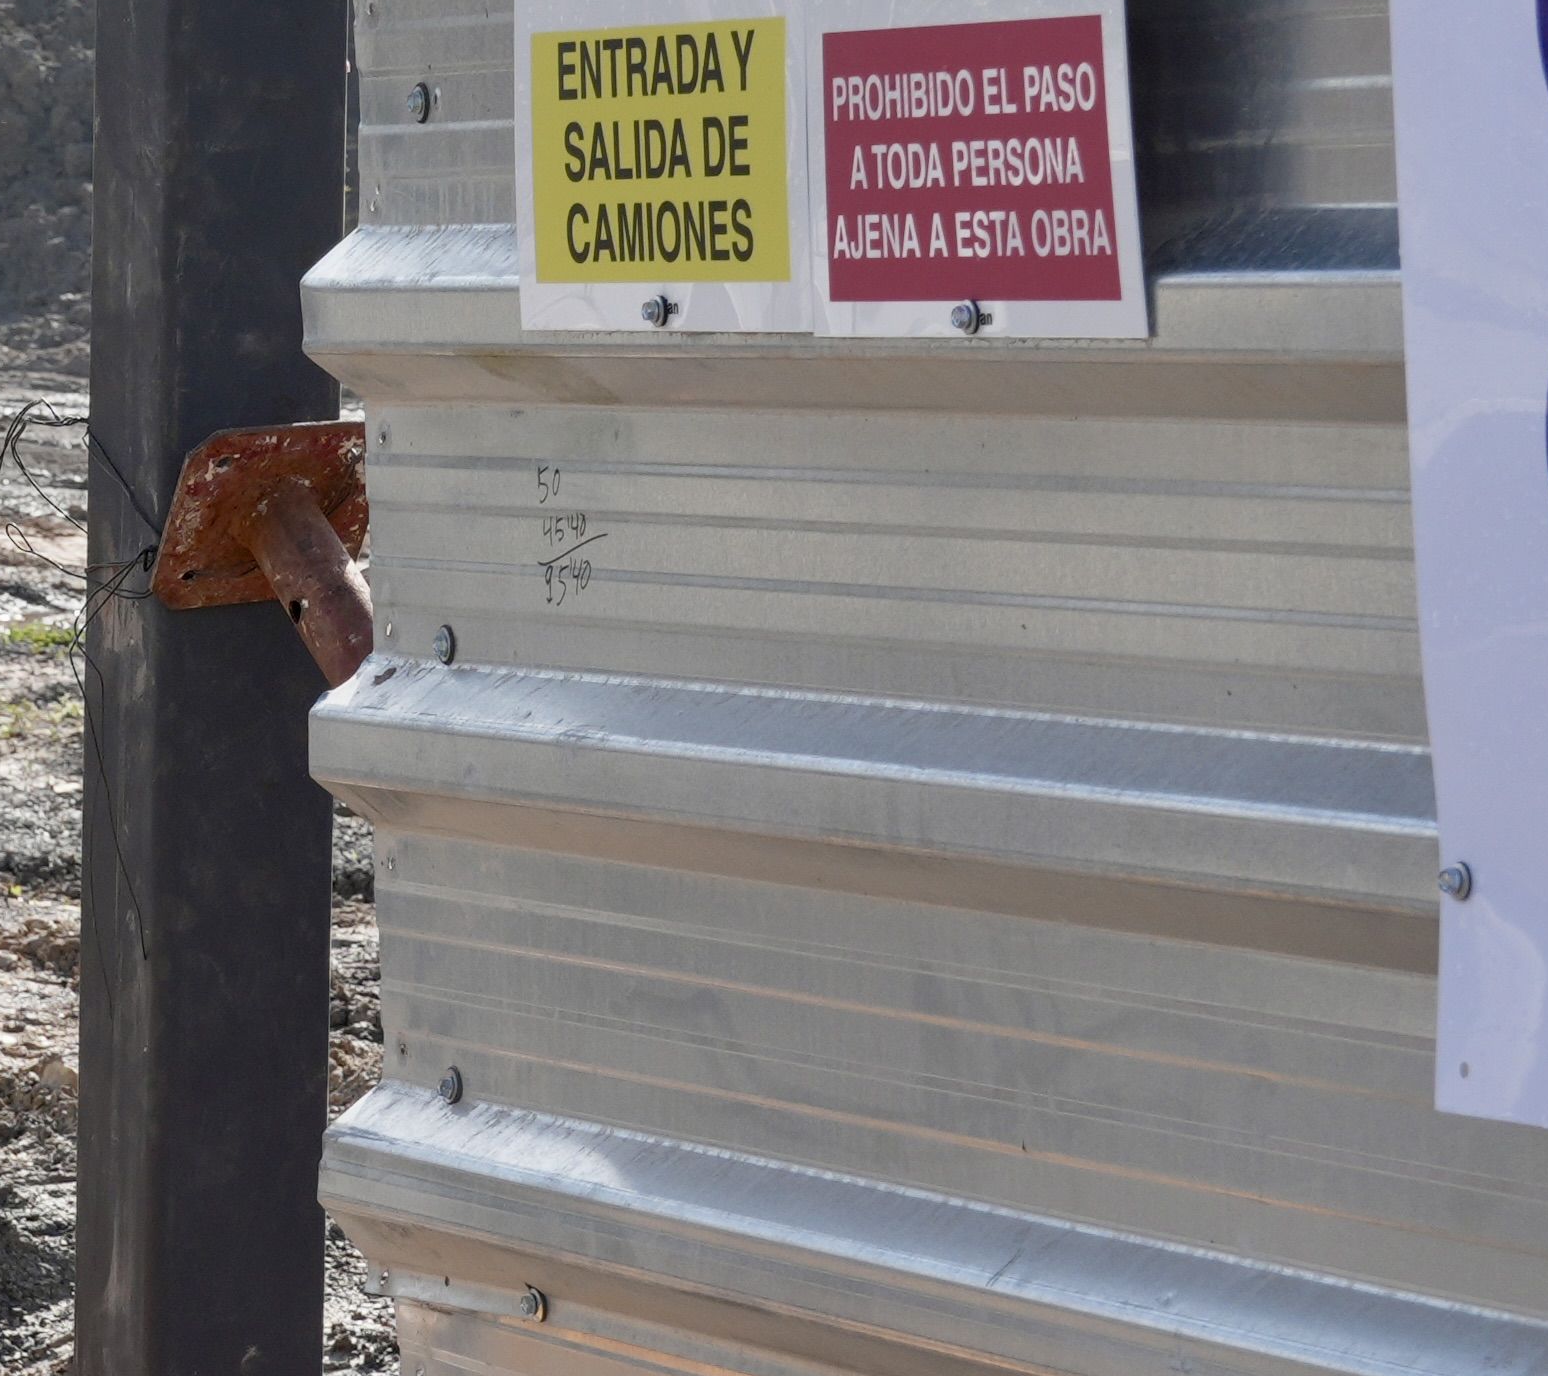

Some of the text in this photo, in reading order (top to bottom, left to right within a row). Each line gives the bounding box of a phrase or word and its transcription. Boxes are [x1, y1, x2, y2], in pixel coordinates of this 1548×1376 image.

[557, 29, 755, 101] ENTRADA Y
[832, 62, 1096, 122] PROHIBIDO EL PASO
[564, 115, 751, 183] SALIDA DE
[850, 136, 1085, 190] A TODA PERSONA
[566, 198, 754, 264] CAMIONES
[833, 208, 1112, 259] AJENA A ESTA OBRA
[537, 466, 561, 504] 50
